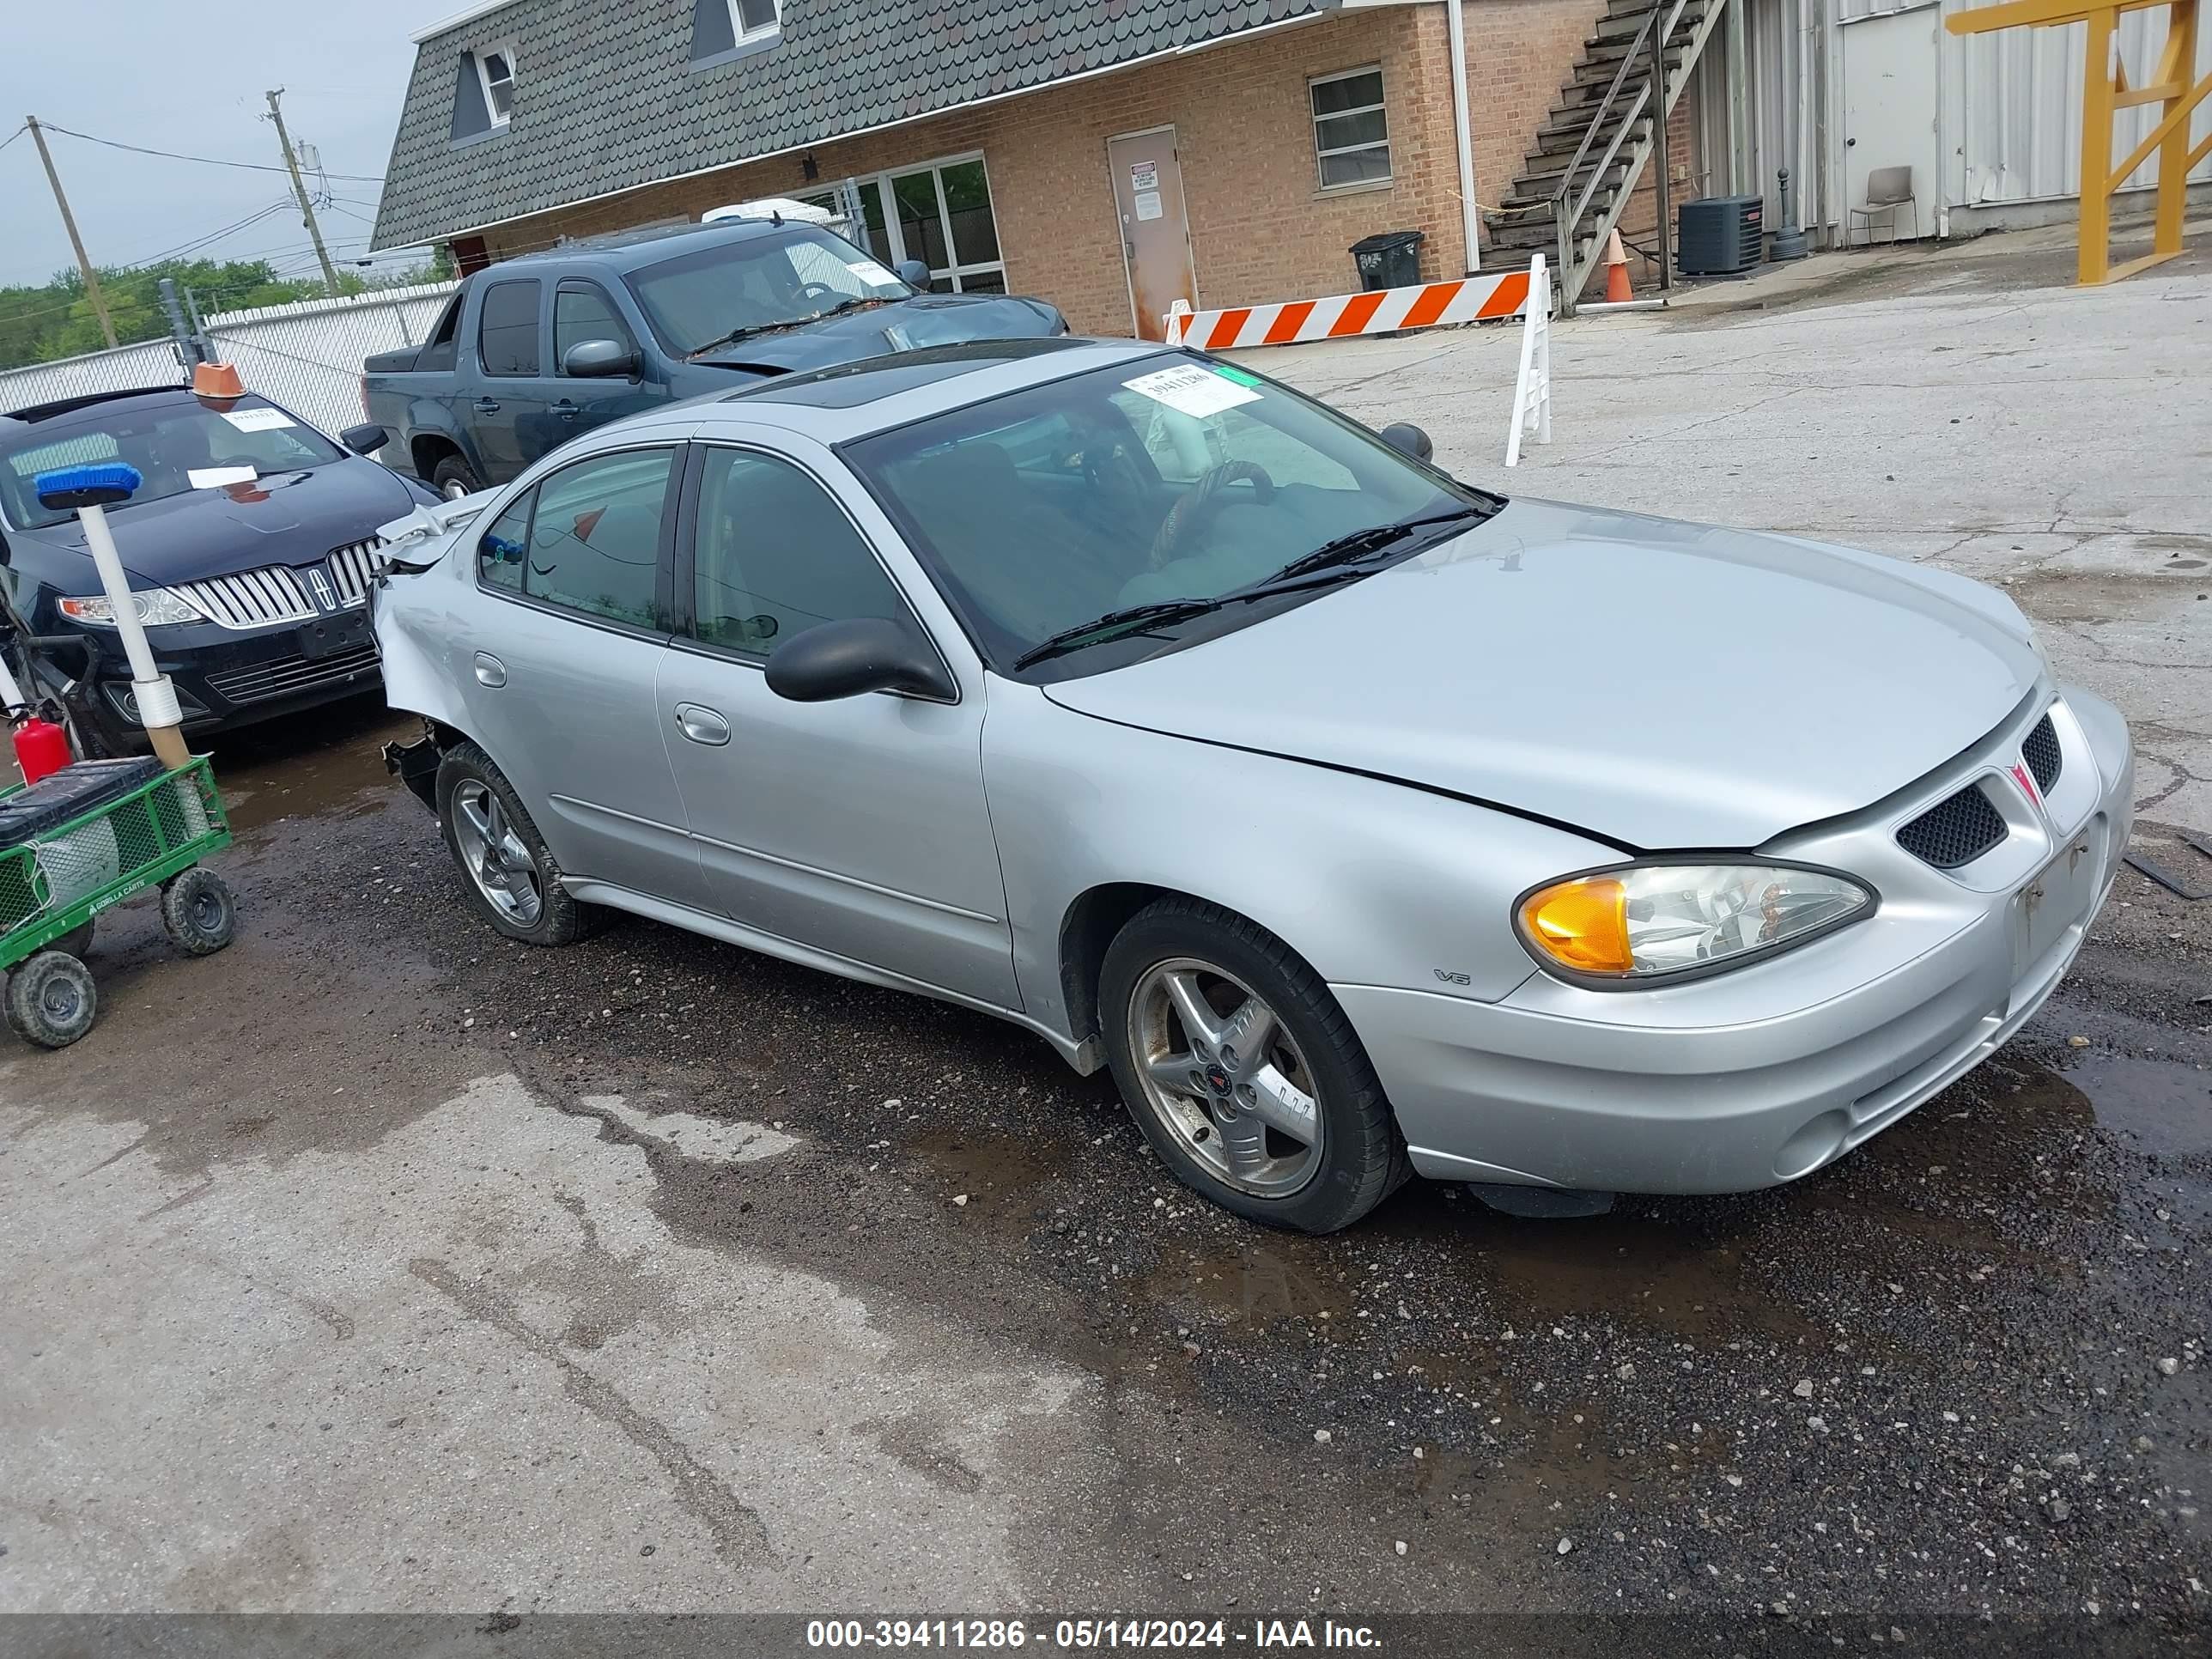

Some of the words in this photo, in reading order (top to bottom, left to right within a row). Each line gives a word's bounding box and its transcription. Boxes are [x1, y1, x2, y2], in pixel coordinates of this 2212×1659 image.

[1147, 374, 1209, 396] 39411286
[96, 891, 124, 910] GORILLA
[124, 879, 145, 895] CARTS
[1434, 969, 1470, 985] V6
